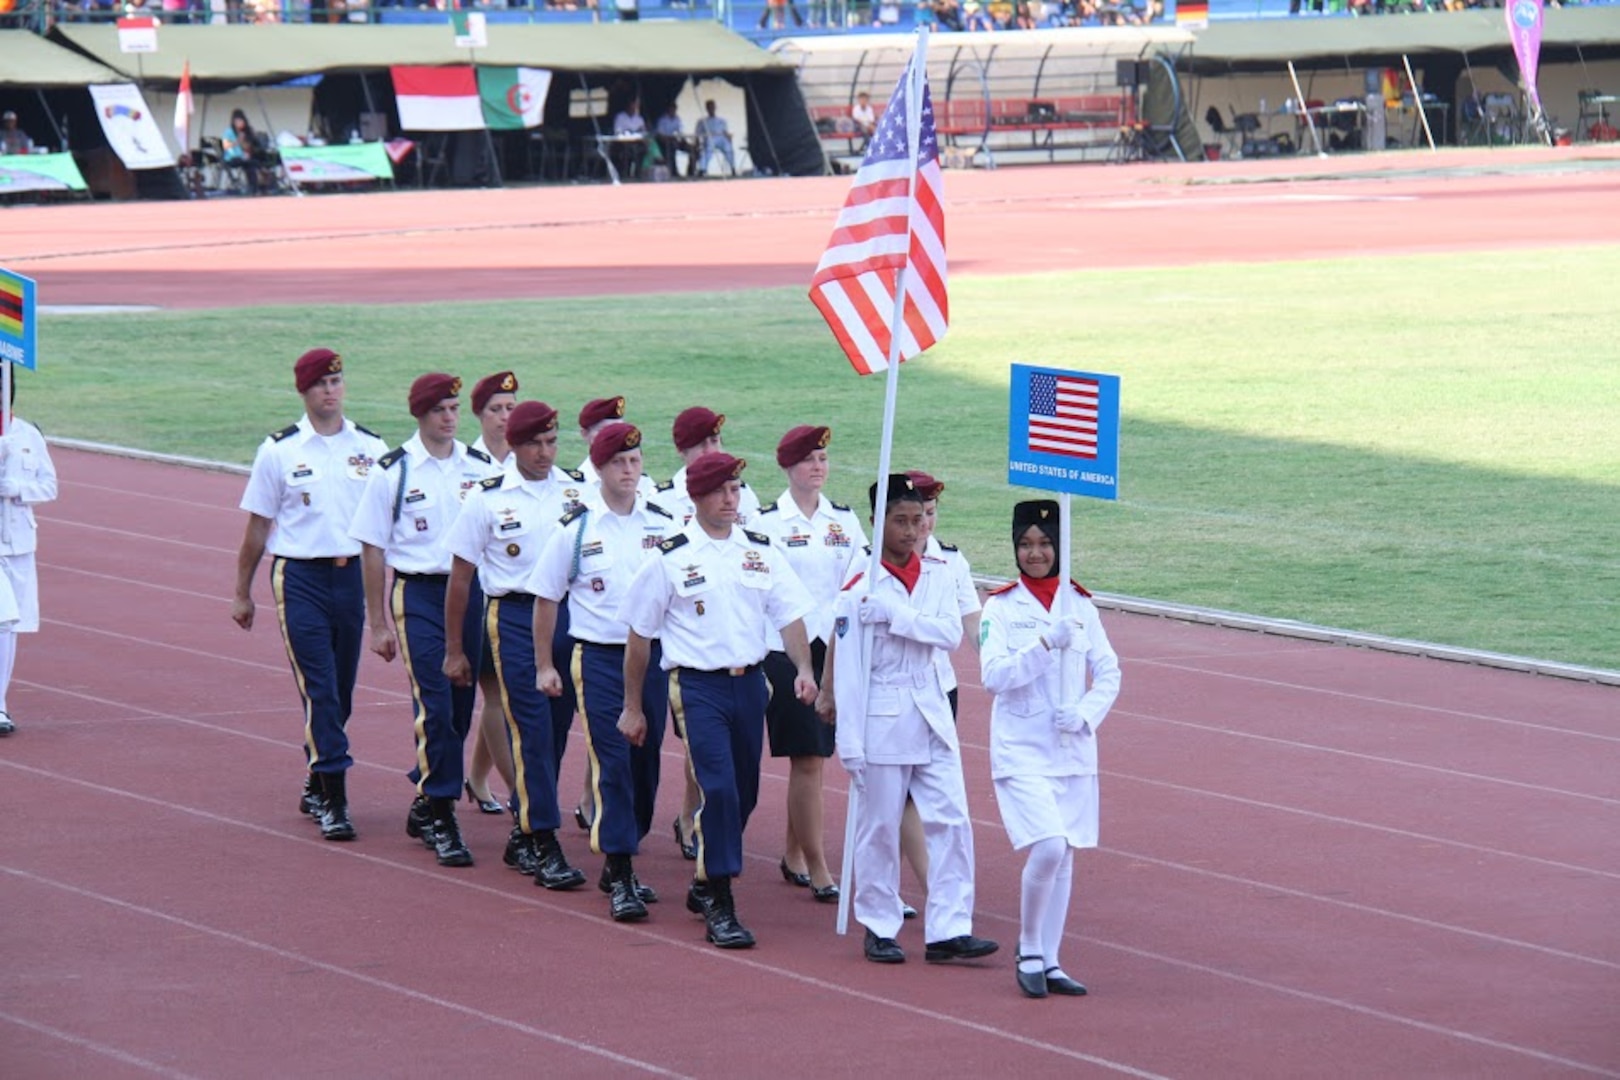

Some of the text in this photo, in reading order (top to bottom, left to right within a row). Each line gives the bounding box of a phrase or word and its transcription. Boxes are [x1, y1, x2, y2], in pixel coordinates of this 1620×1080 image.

[1010, 461, 1115, 485] UNITED STATES OF AMERICA
